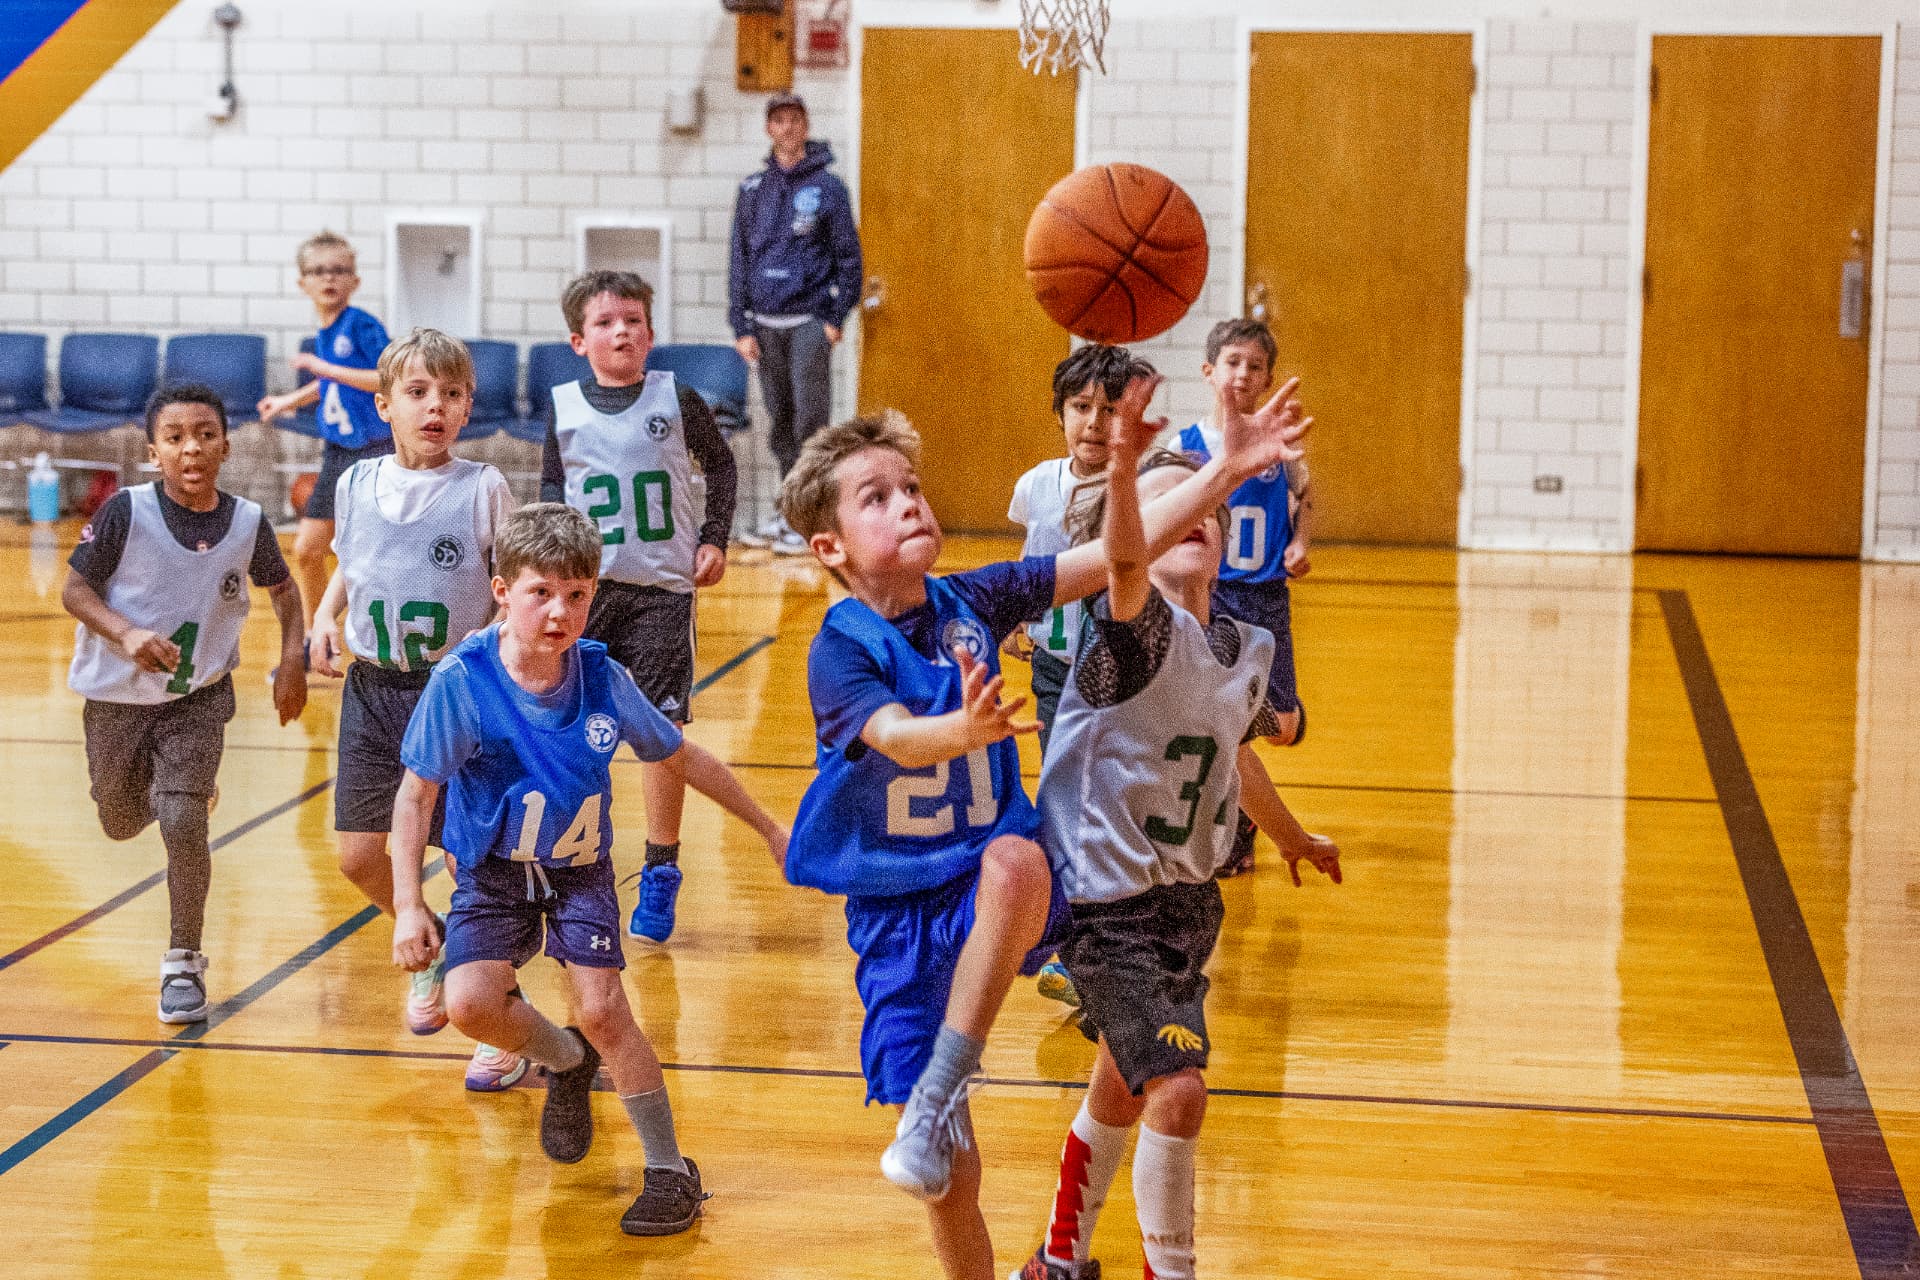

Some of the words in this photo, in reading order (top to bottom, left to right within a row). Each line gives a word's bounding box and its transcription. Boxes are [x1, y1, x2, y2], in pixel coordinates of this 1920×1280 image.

[323, 382, 354, 435] 4
[583, 470, 675, 545] 20
[368, 600, 449, 670] 12
[887, 744, 997, 836] 21
[510, 790, 601, 867] 14
